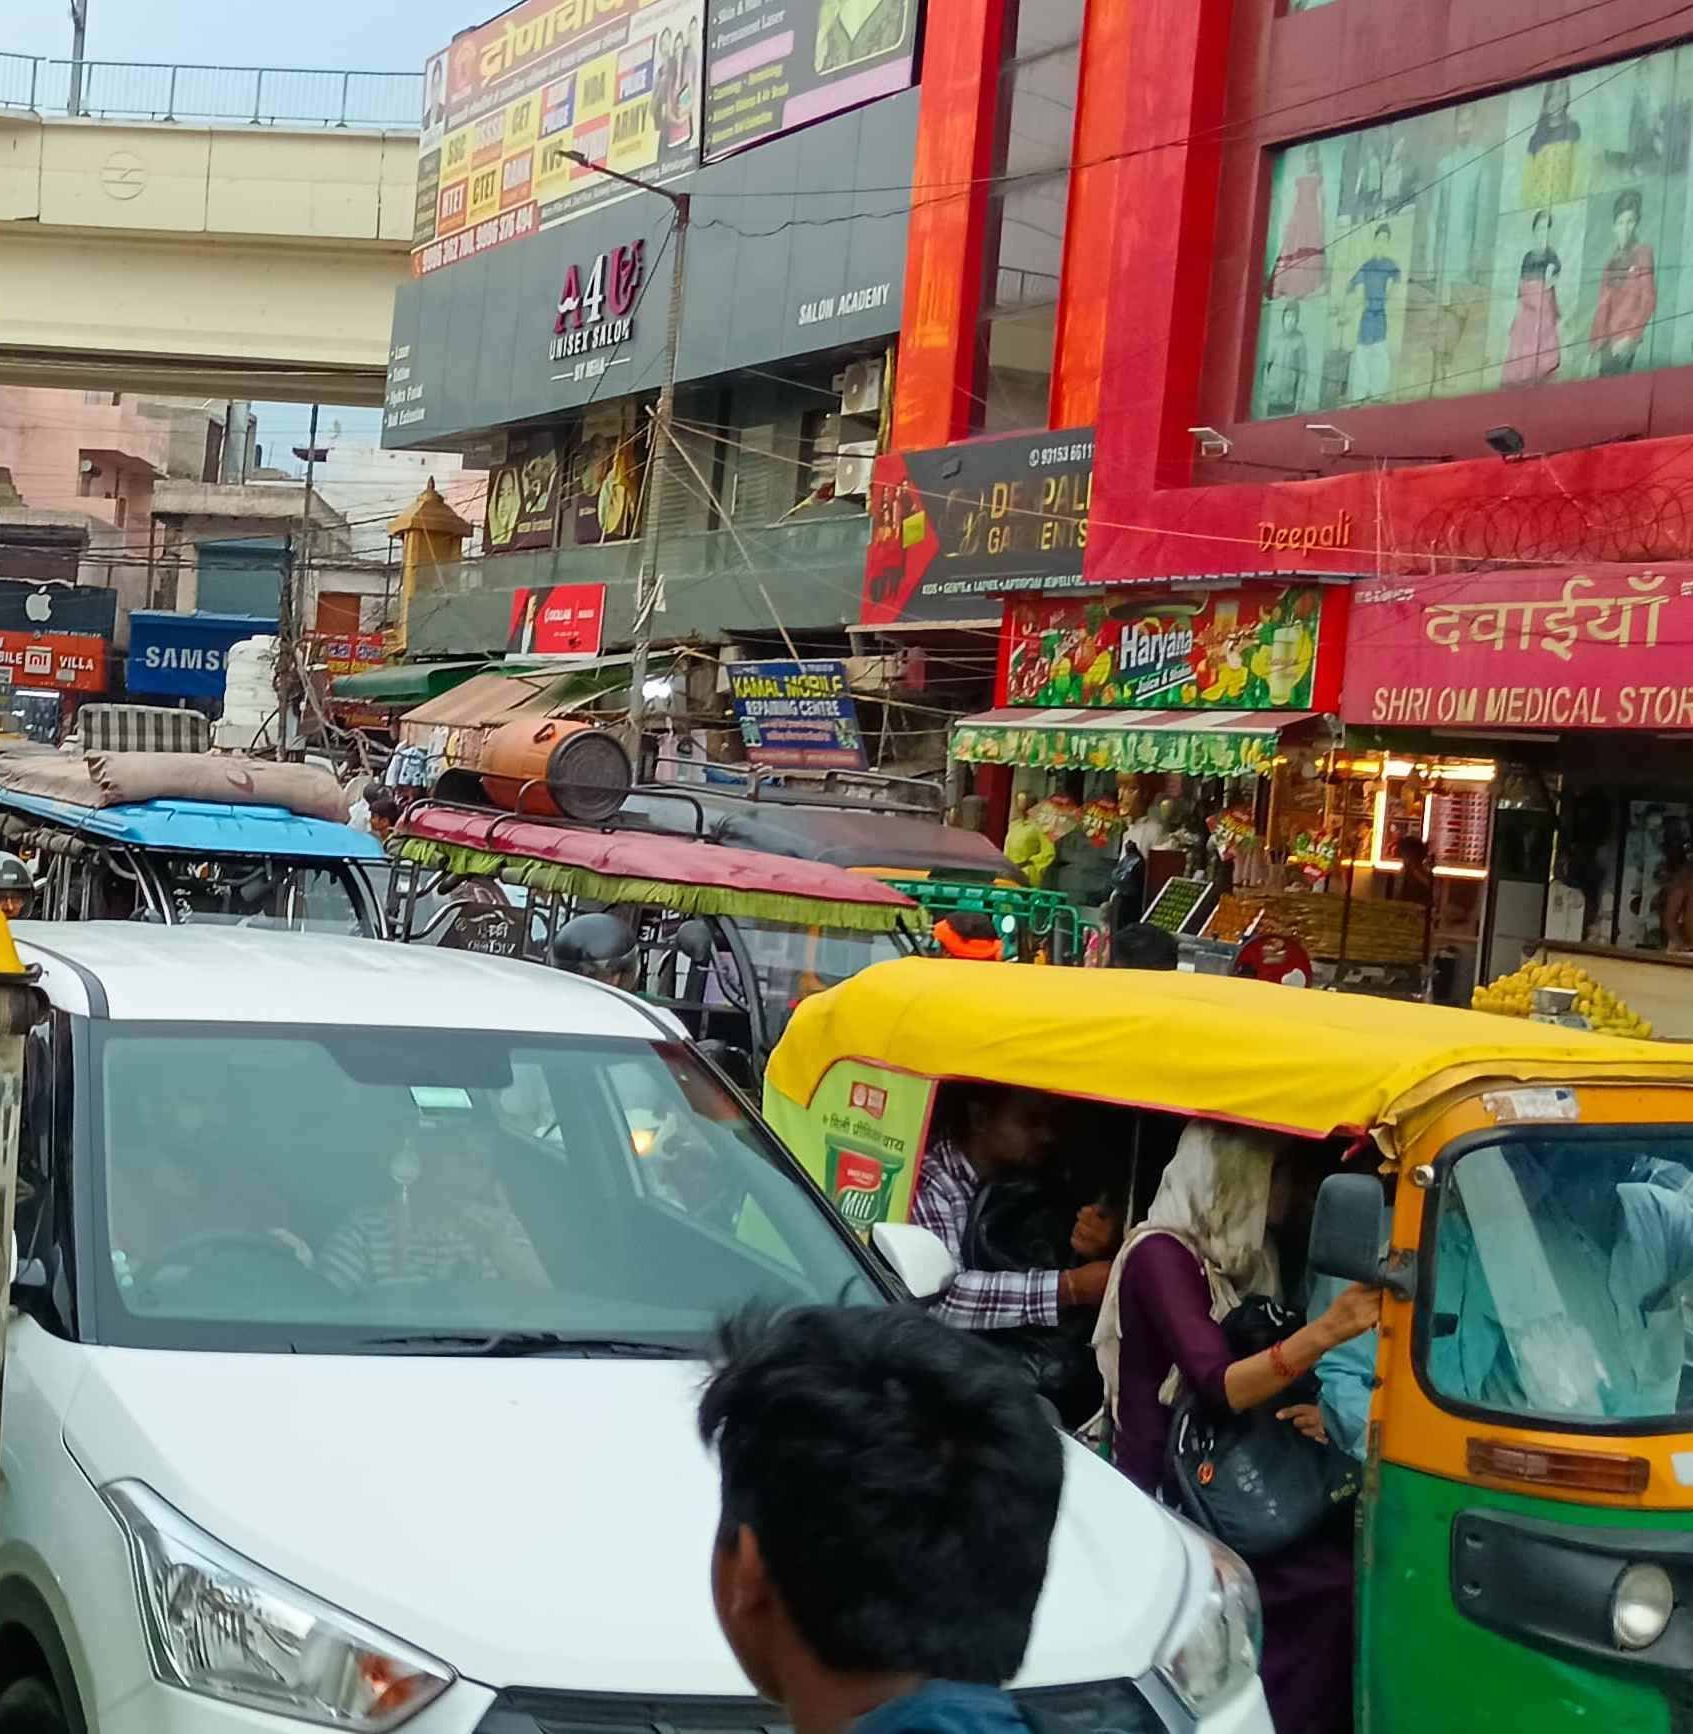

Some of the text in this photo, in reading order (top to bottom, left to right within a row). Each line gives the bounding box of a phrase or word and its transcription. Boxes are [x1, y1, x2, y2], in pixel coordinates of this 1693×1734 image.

[798, 282, 891, 326] SALON ACADEMY
[549, 317, 635, 361] UNISEX SALON
[1259, 508, 1353, 558] Deepali
[1423, 570, 1670, 661] दवाईयाँ
[59, 655, 94, 671] VILLA
[1119, 625, 1193, 671] Haryana
[732, 675, 843, 699] KAMAL MOBILE
[745, 701, 841, 716] REPAIRING CENTRE
[1372, 687, 1432, 723] SHRI
[1437, 687, 1478, 723] OM
[1484, 687, 1607, 724] MEDICAL
